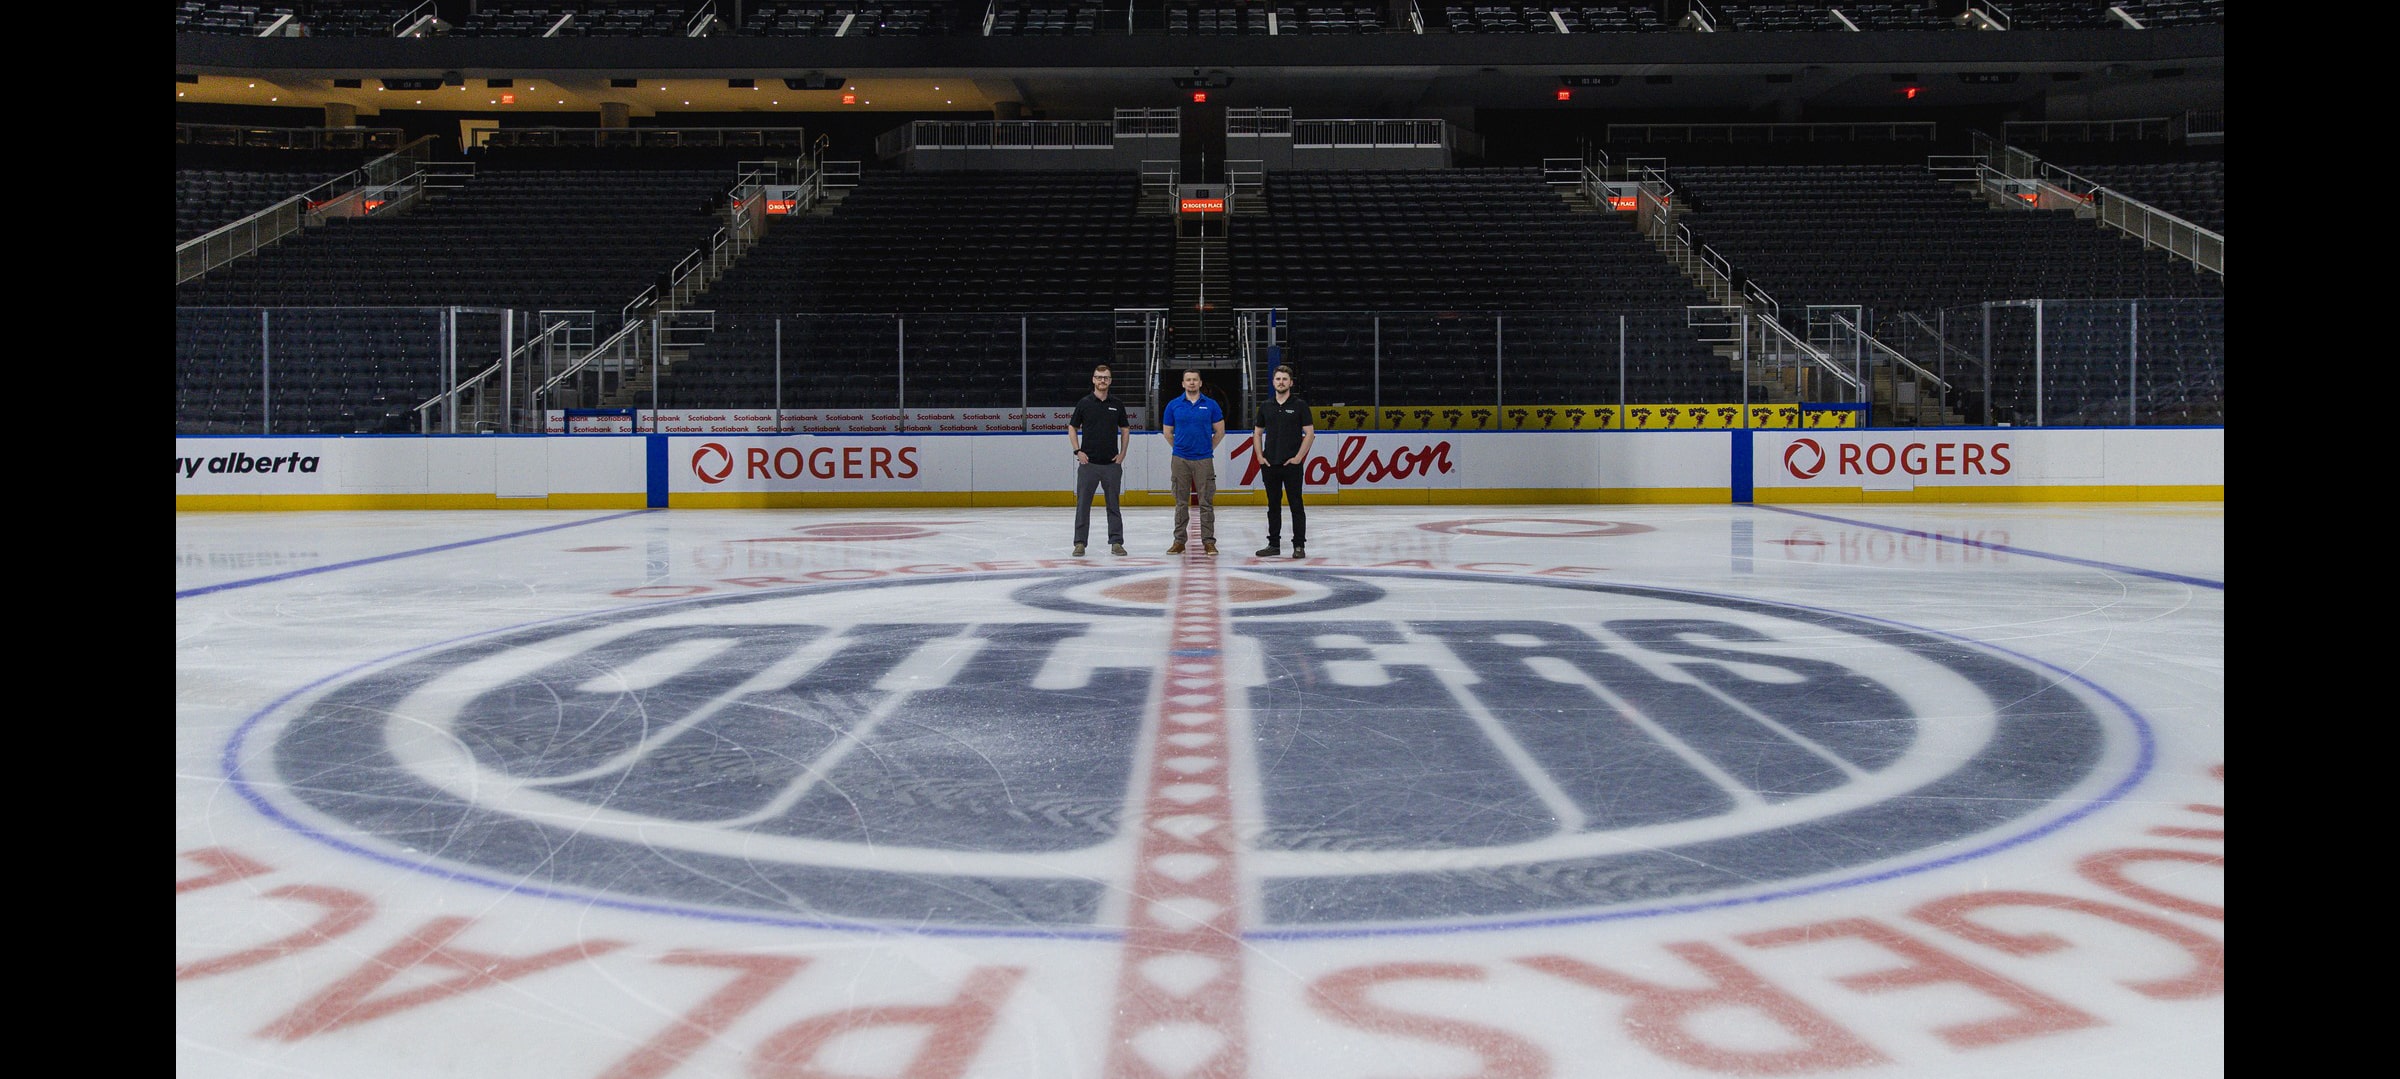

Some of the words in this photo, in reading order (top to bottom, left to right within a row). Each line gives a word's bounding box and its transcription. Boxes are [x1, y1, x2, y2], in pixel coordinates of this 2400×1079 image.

[711, 425, 749, 433] Scotiabank
[733, 414, 772, 422] Scotiabank
[916, 413, 955, 421] Scotiabank
[962, 413, 1001, 421] Scotiabank
[208, 452, 320, 473] alberta
[747, 446, 919, 479] ROGERS
[1839, 443, 2011, 475] ROGERS
[714, 556, 1168, 588] ROGERS
[1243, 557, 1613, 577] PLACE
